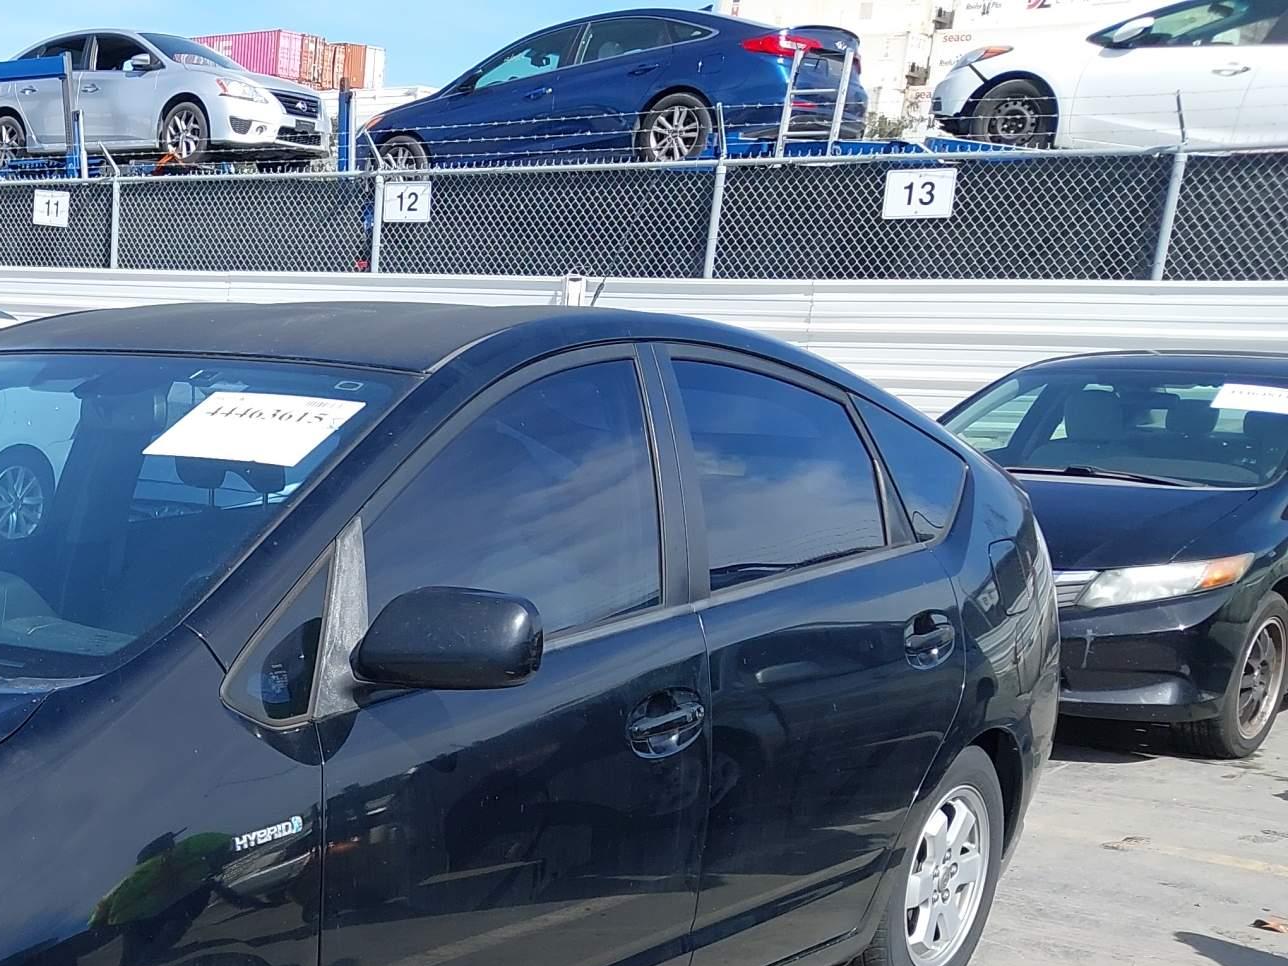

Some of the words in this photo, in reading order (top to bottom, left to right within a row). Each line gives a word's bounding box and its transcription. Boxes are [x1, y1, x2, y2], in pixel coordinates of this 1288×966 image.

[943, 34, 972, 43] seaco
[396, 191, 419, 212] 12
[904, 181, 935, 206] 13
[45, 199, 59, 217] 11
[234, 821, 294, 851] HYBRID
